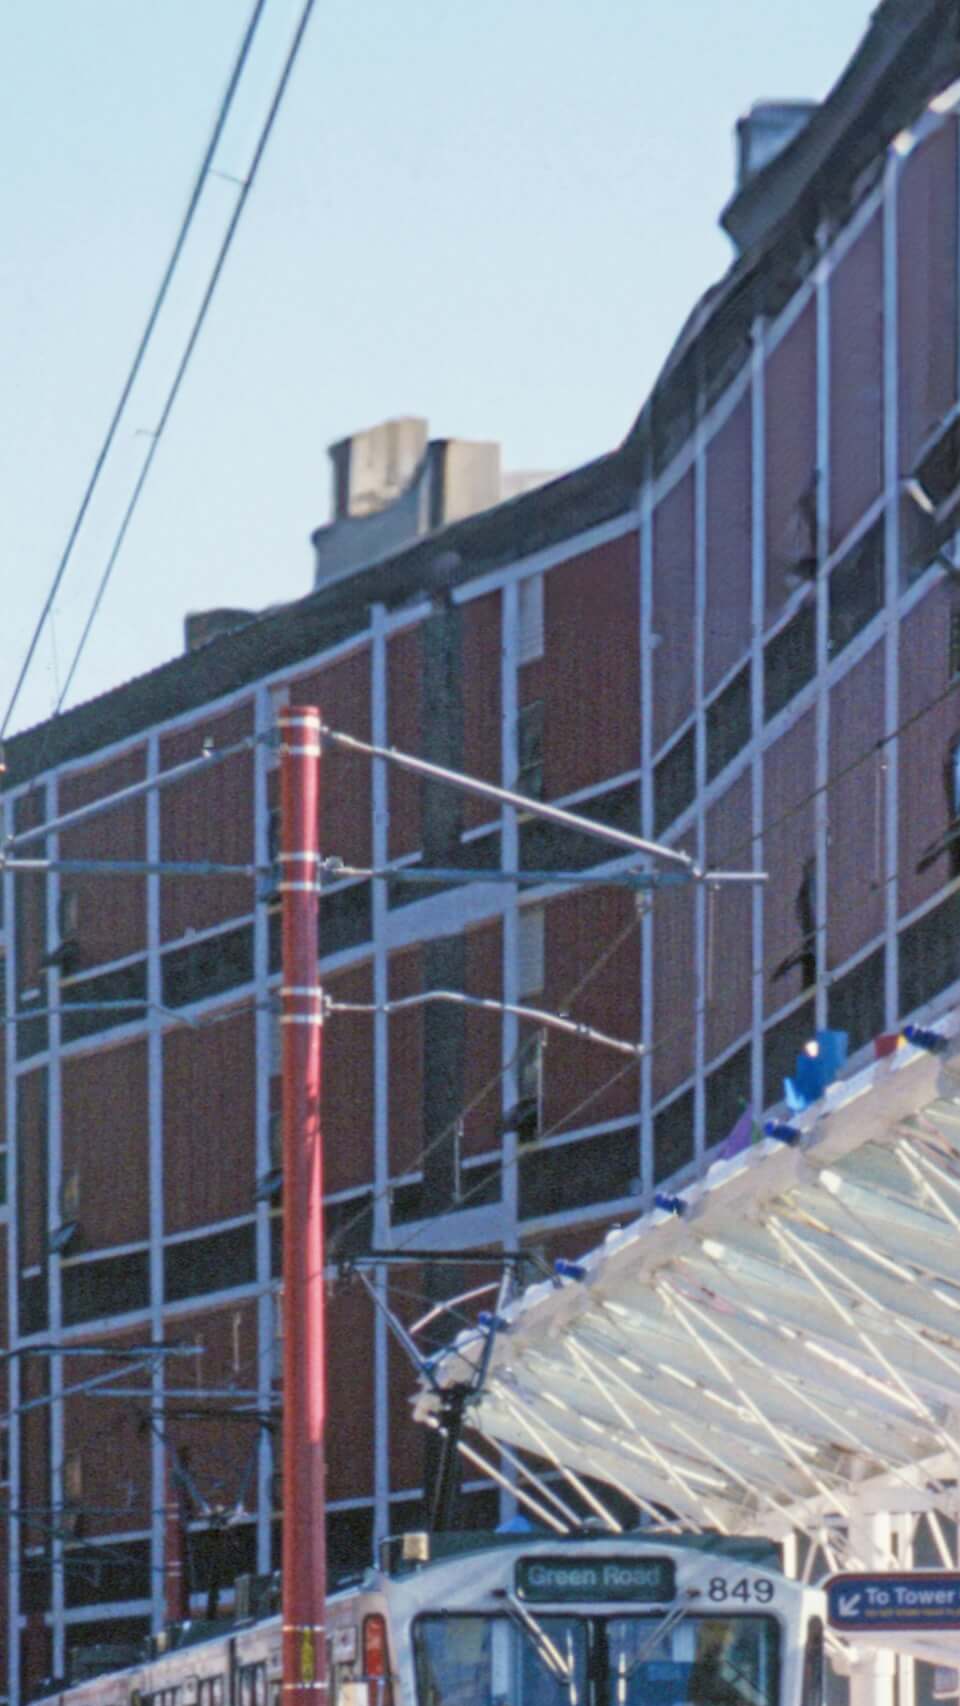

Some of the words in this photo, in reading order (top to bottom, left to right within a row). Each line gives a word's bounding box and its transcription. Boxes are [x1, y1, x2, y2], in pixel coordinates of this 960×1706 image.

[528, 1565, 596, 1585] Green
[603, 1565, 661, 1585] Road
[708, 1577, 774, 1603] 849
[864, 1587, 889, 1604] To
[893, 1587, 955, 1605] Tower
